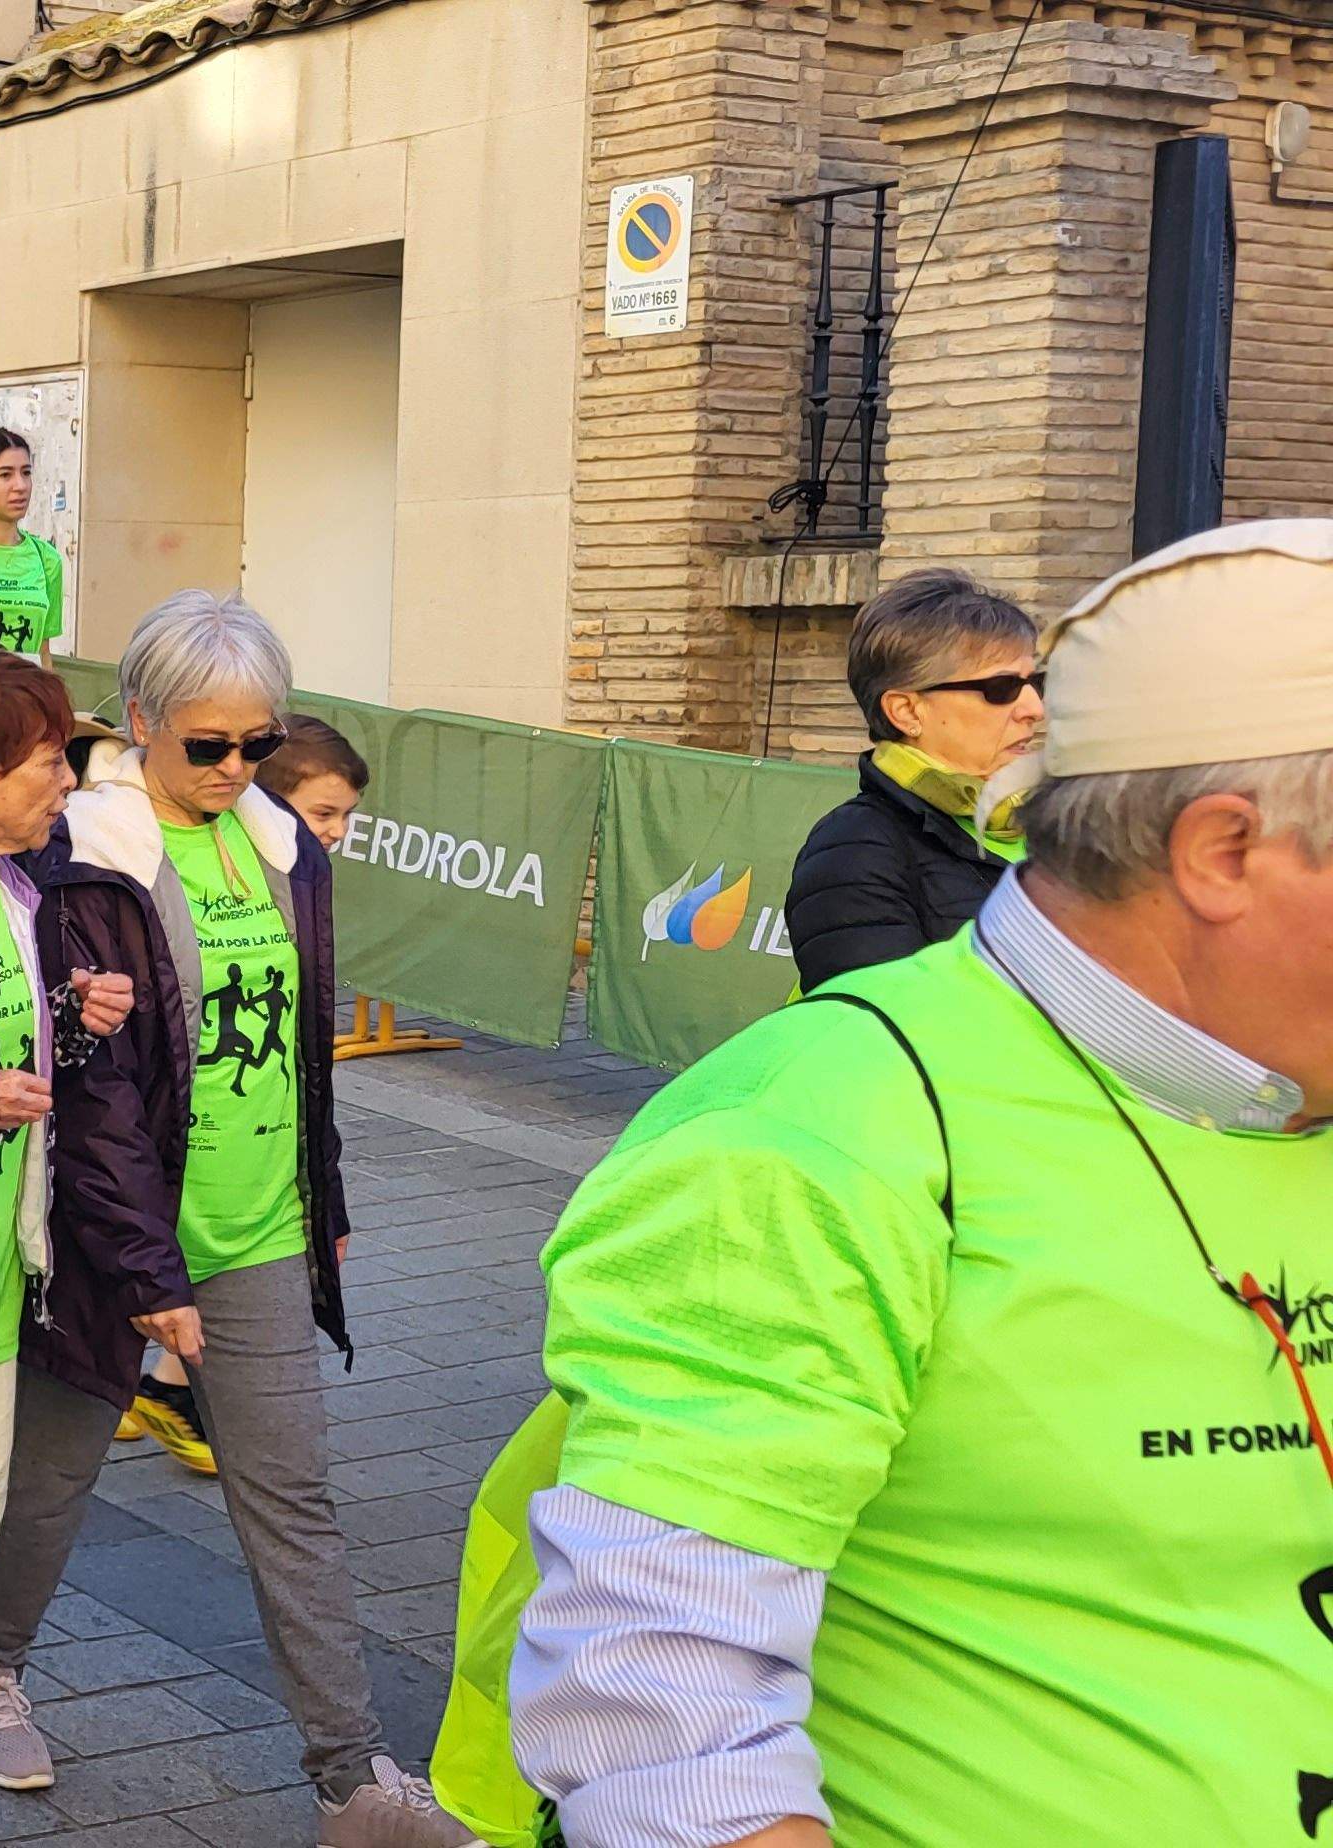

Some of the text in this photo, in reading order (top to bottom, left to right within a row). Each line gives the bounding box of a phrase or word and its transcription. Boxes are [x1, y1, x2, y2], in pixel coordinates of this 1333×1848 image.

[611, 295, 637, 311] VADO
[227, 938, 250, 949] POR
[253, 935, 269, 946] LA
[11, 1001, 25, 1016] LA
[1140, 1428, 1194, 1458] EN
